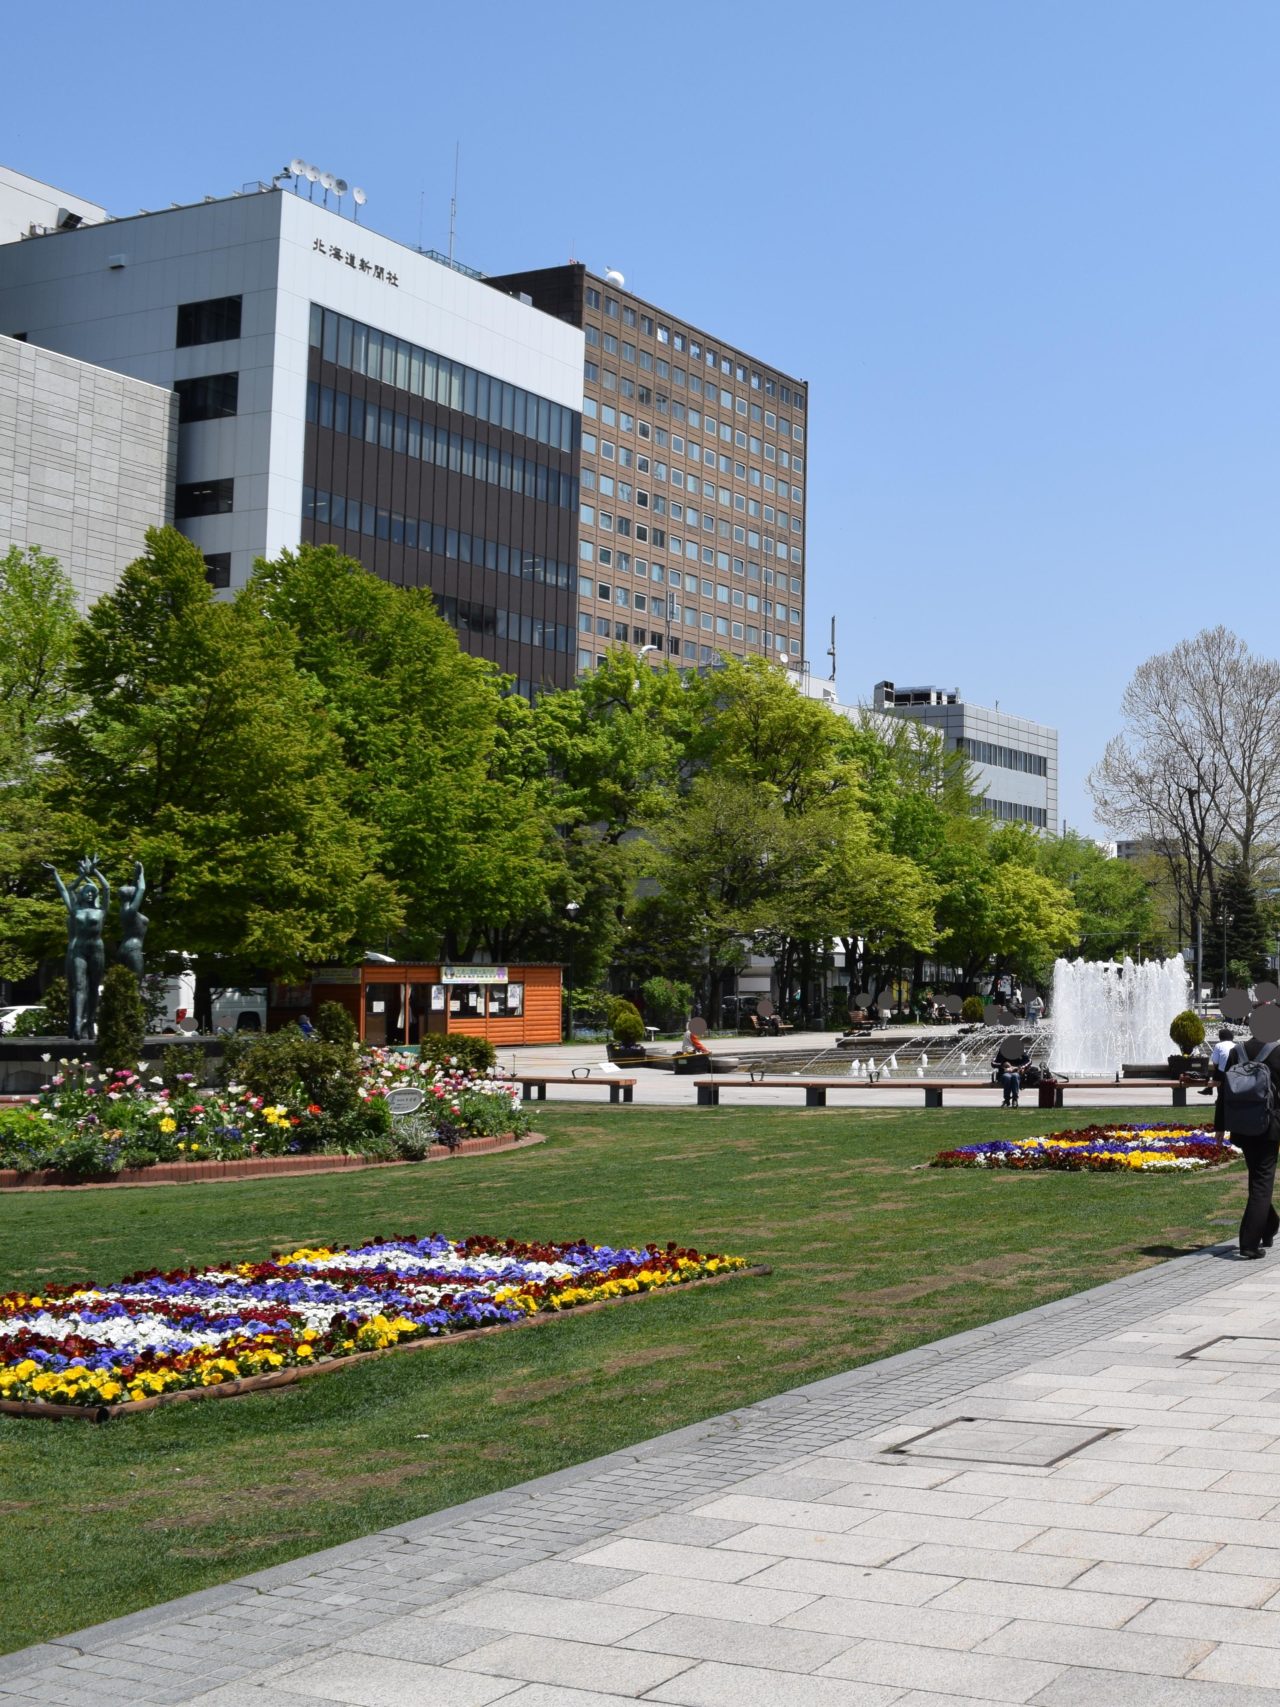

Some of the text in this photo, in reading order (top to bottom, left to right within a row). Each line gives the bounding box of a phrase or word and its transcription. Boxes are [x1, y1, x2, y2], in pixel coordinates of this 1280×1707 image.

[312, 238, 399, 288] 北海道新聞社
